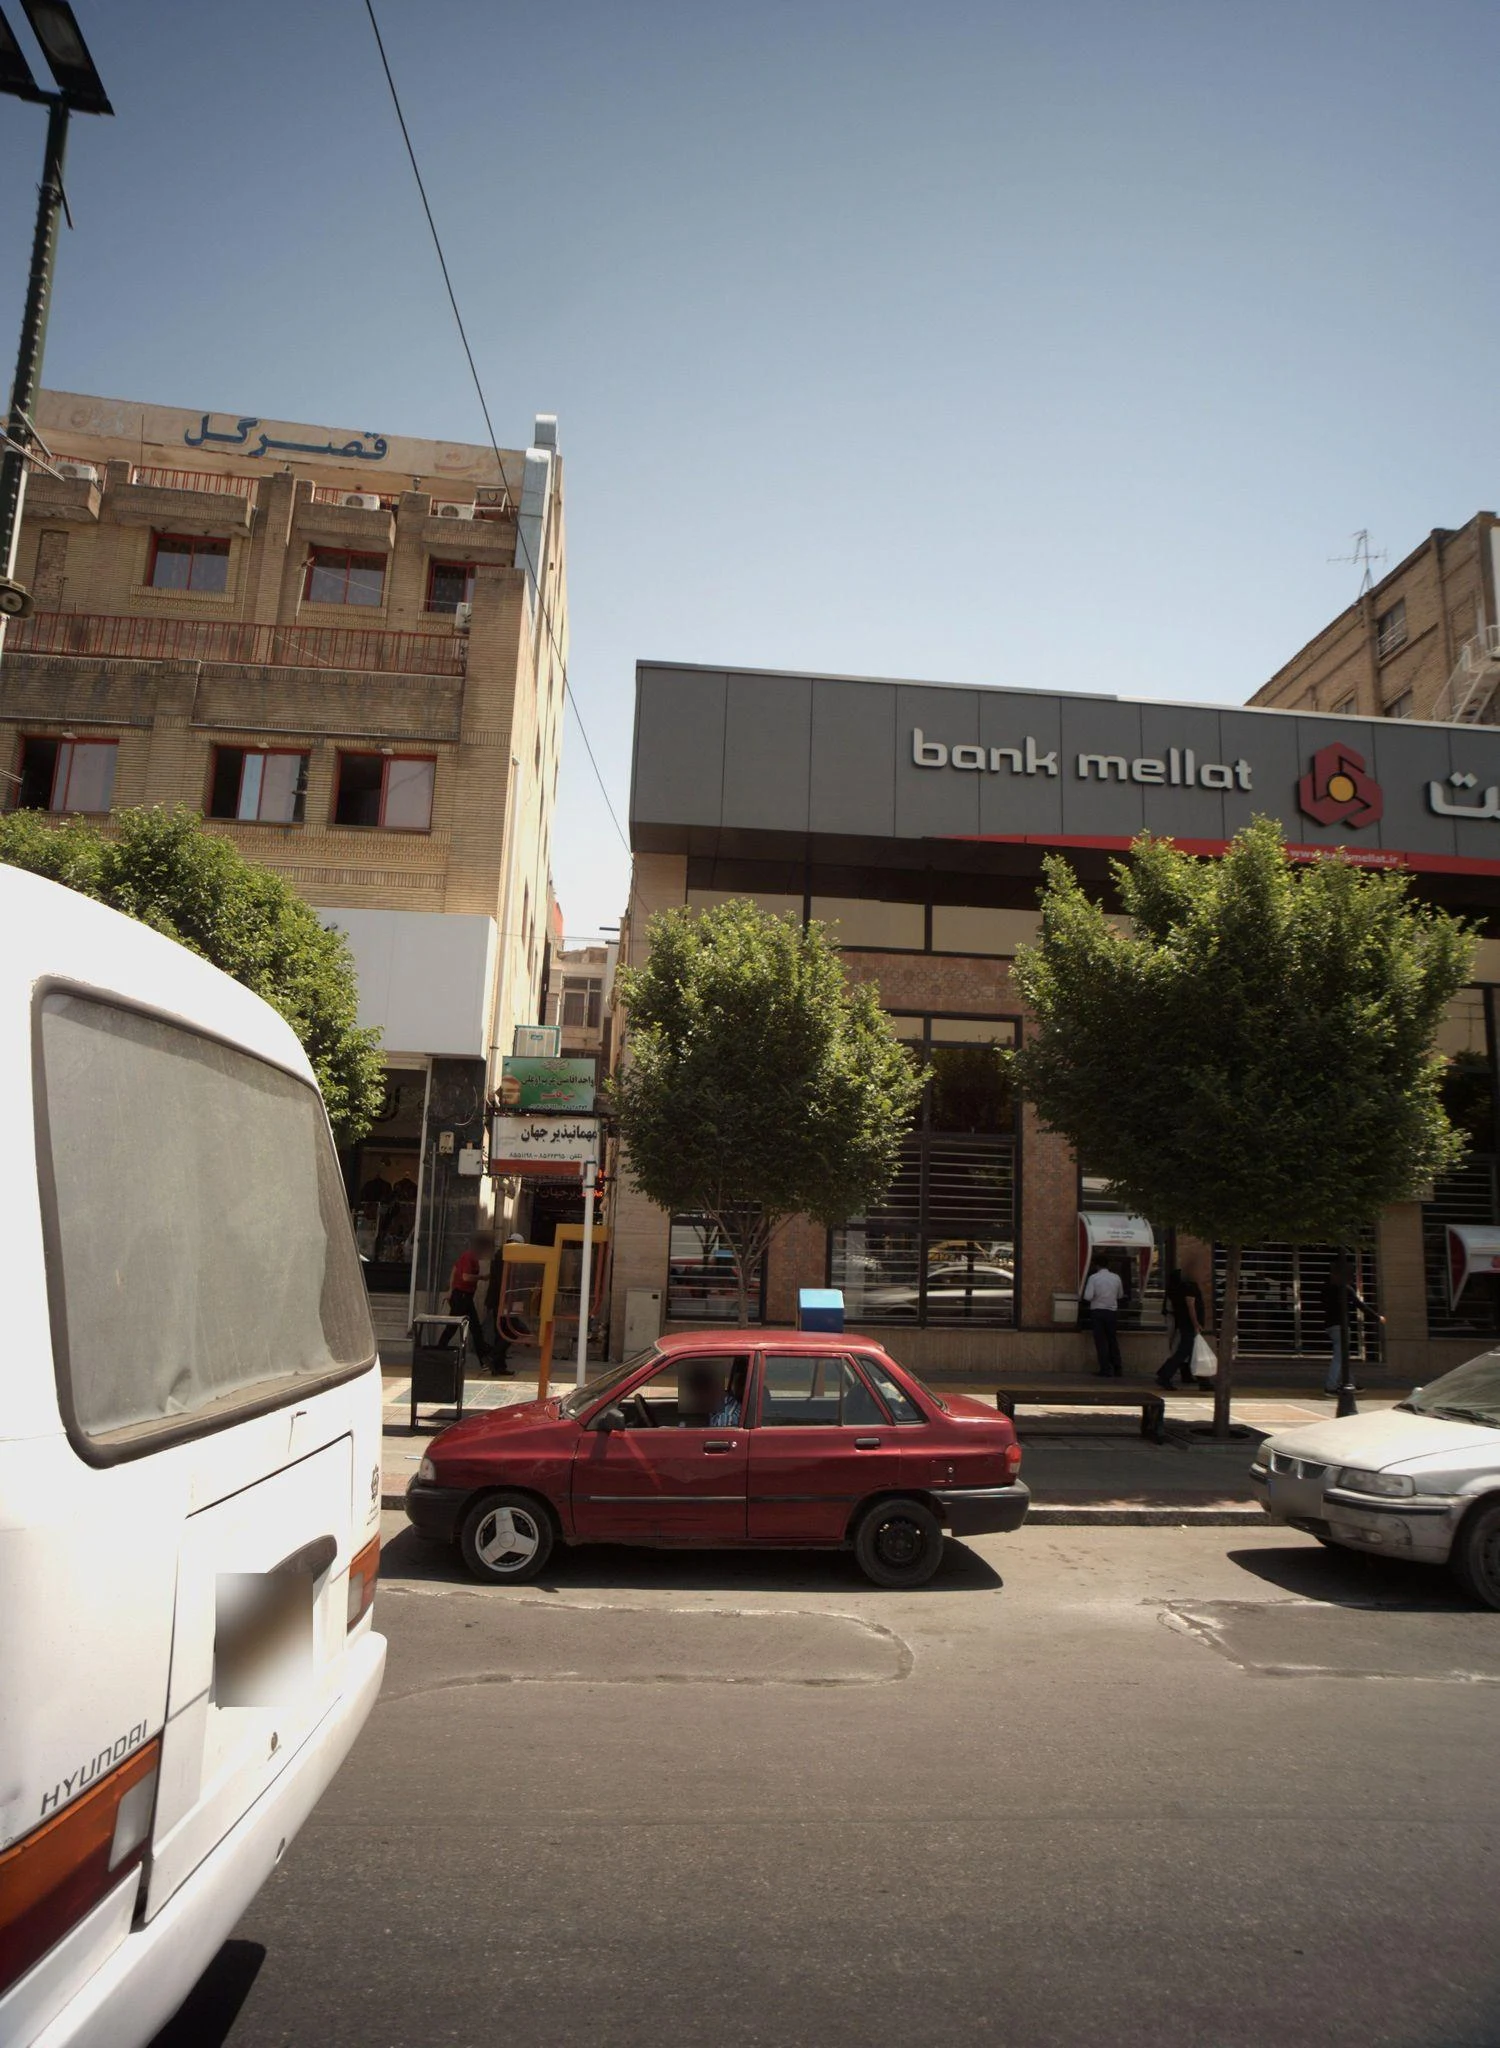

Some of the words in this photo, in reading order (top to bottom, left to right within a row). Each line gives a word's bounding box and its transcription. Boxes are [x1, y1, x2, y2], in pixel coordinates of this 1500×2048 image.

[184, 413, 258, 447] گل
[249, 431, 388, 460] قصر
[911, 727, 1058, 777] bank
[1077, 746, 1254, 792] mellat
[520, 1124, 549, 1143] جهان
[550, 1124, 598, 1143] مهمانپذیر
[40, 1718, 148, 1816] HYUNDAI
